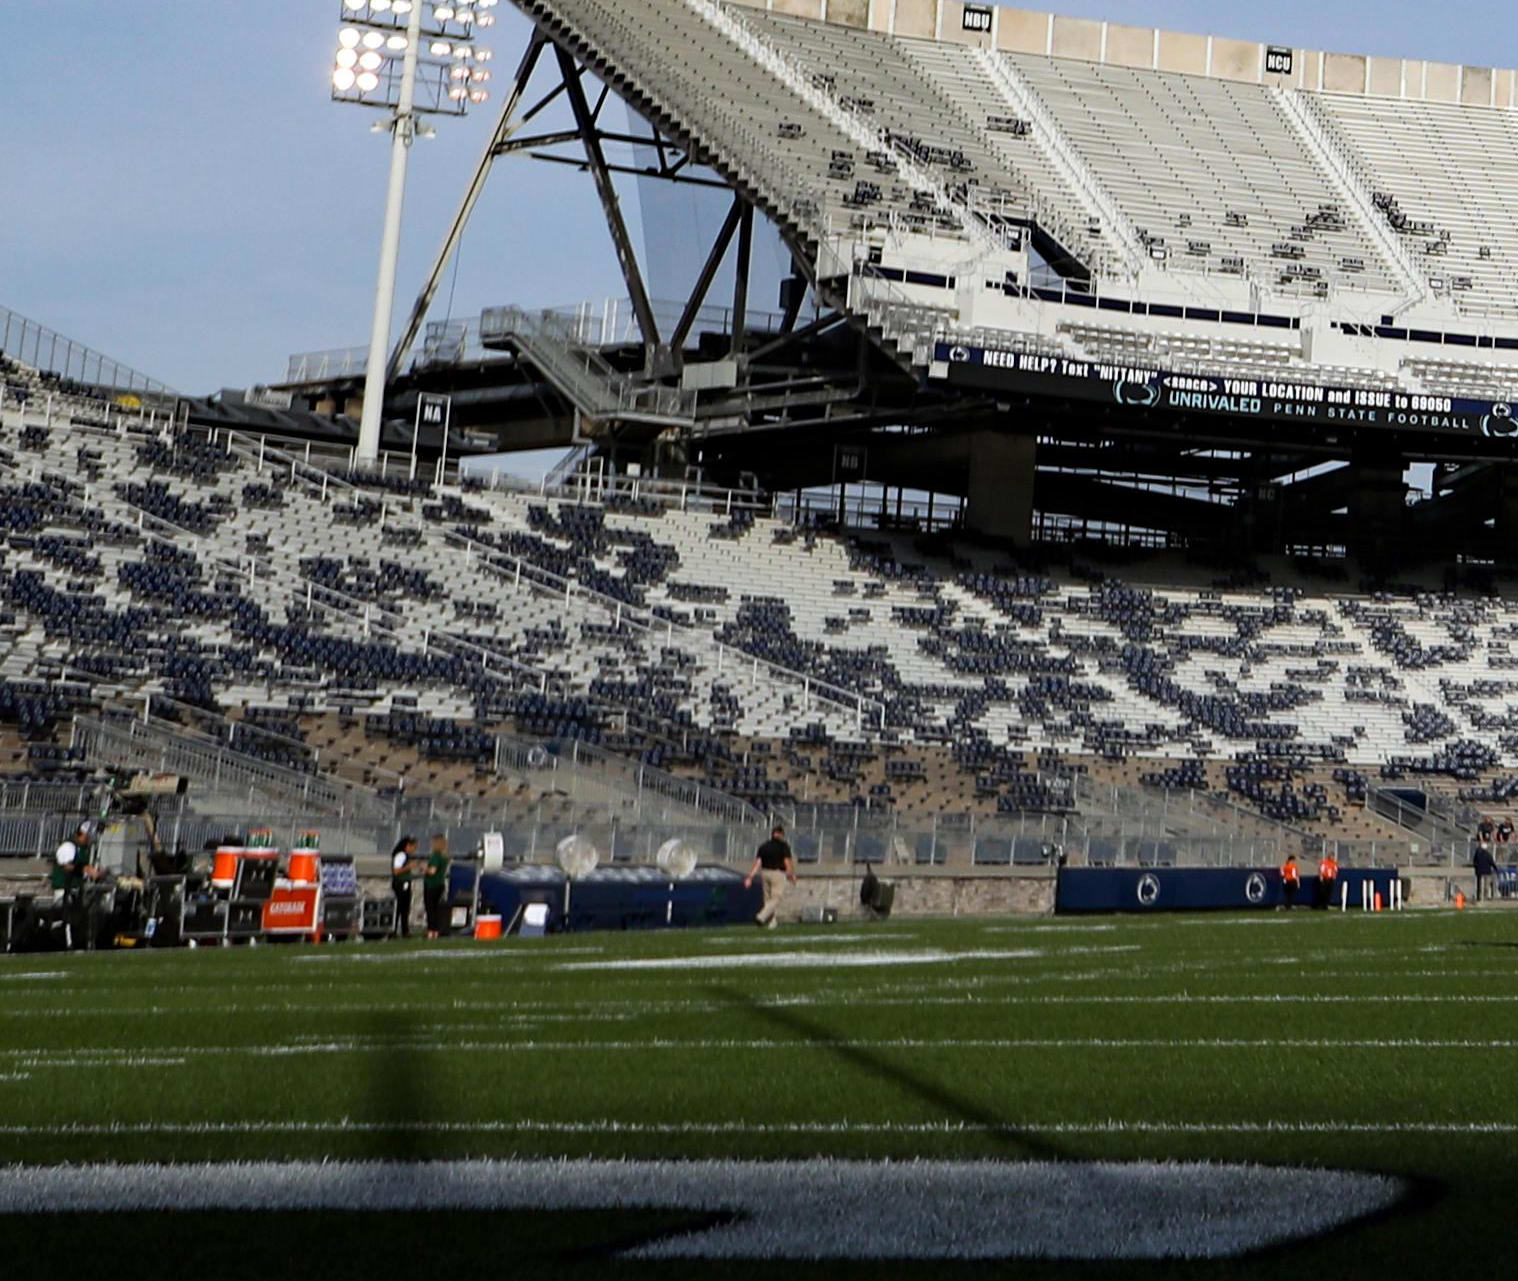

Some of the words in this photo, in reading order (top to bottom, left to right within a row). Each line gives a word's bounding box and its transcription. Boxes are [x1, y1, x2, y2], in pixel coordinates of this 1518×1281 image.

[1268, 53, 1291, 71] NCU
[983, 350, 1015, 368] NEED
[1019, 354, 1057, 373] HELP?
[1061, 360, 1089, 377] Text
[1093, 365, 1158, 384] "NITTANY"
[1224, 380, 1258, 396] YOUR
[1262, 383, 1324, 402] LOCATION
[1328, 390, 1350, 404] and
[1355, 391, 1391, 408] ISSUE
[1395, 396, 1408, 410] to
[1169, 390, 1261, 413] UNRIVALED
[1274, 402, 1316, 417] PENN
[1328, 408, 1377, 422] STATE
[1388, 413, 1469, 429] FOOTBALL
